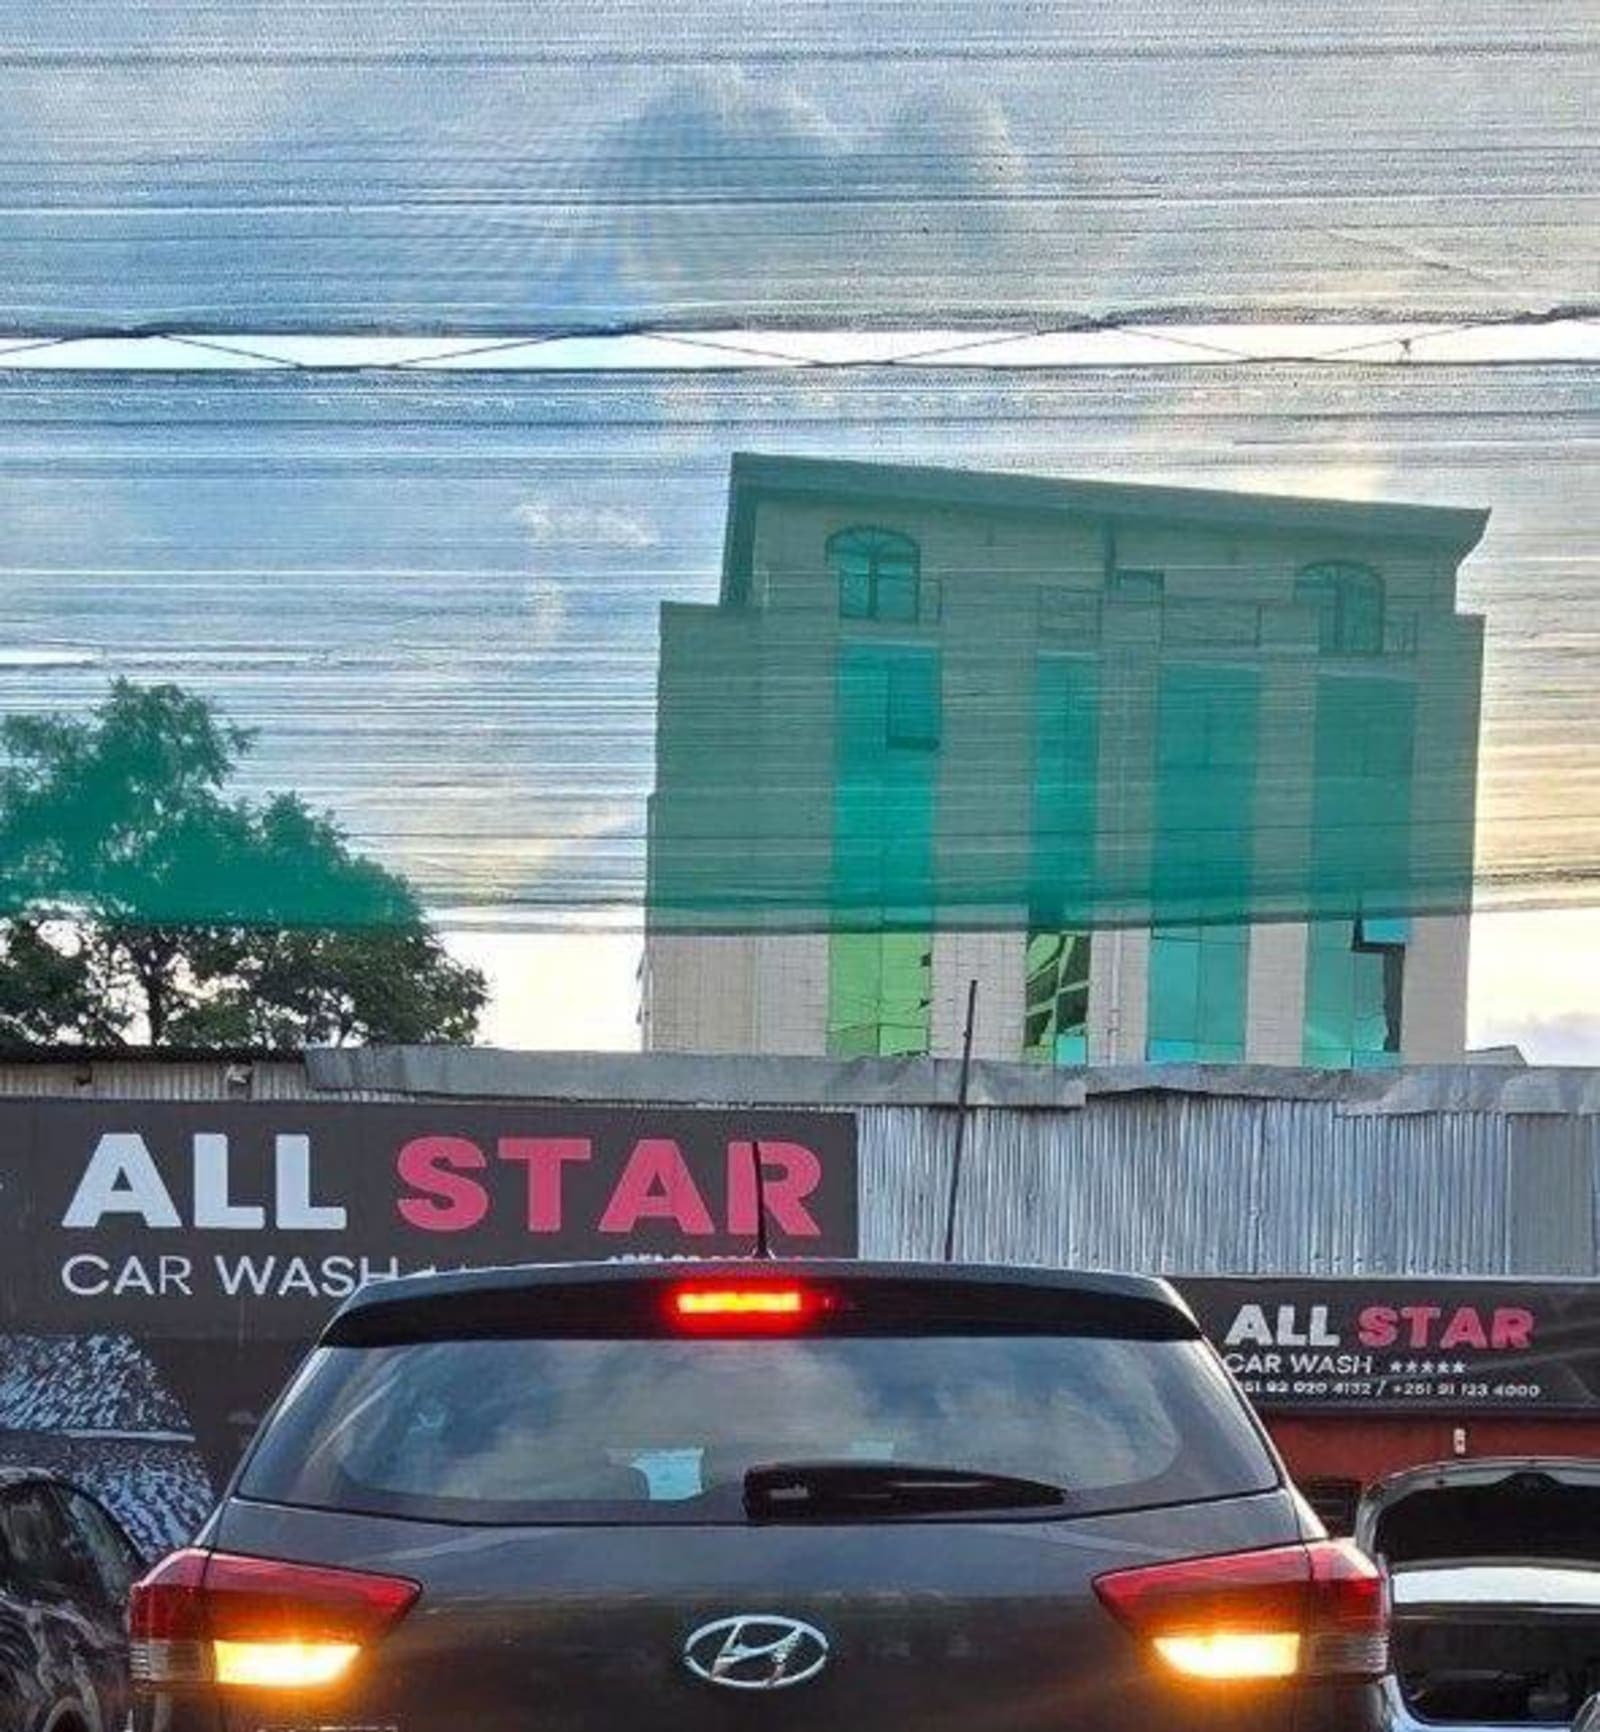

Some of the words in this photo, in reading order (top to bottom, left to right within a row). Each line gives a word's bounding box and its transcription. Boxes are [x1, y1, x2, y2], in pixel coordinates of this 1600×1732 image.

[61, 1132, 347, 1231] ALL
[396, 1135, 823, 1237] STAR
[61, 1254, 193, 1296] CAR
[214, 1254, 399, 1298] WASH
[1225, 1303, 1341, 1347] ALL
[1358, 1305, 1535, 1349] STAR
[1223, 1352, 1283, 1374] CAR
[1290, 1353, 1374, 1374] WASH
[1294, 1380, 1328, 1394] 020
[1493, 1384, 1542, 1397] 4000
